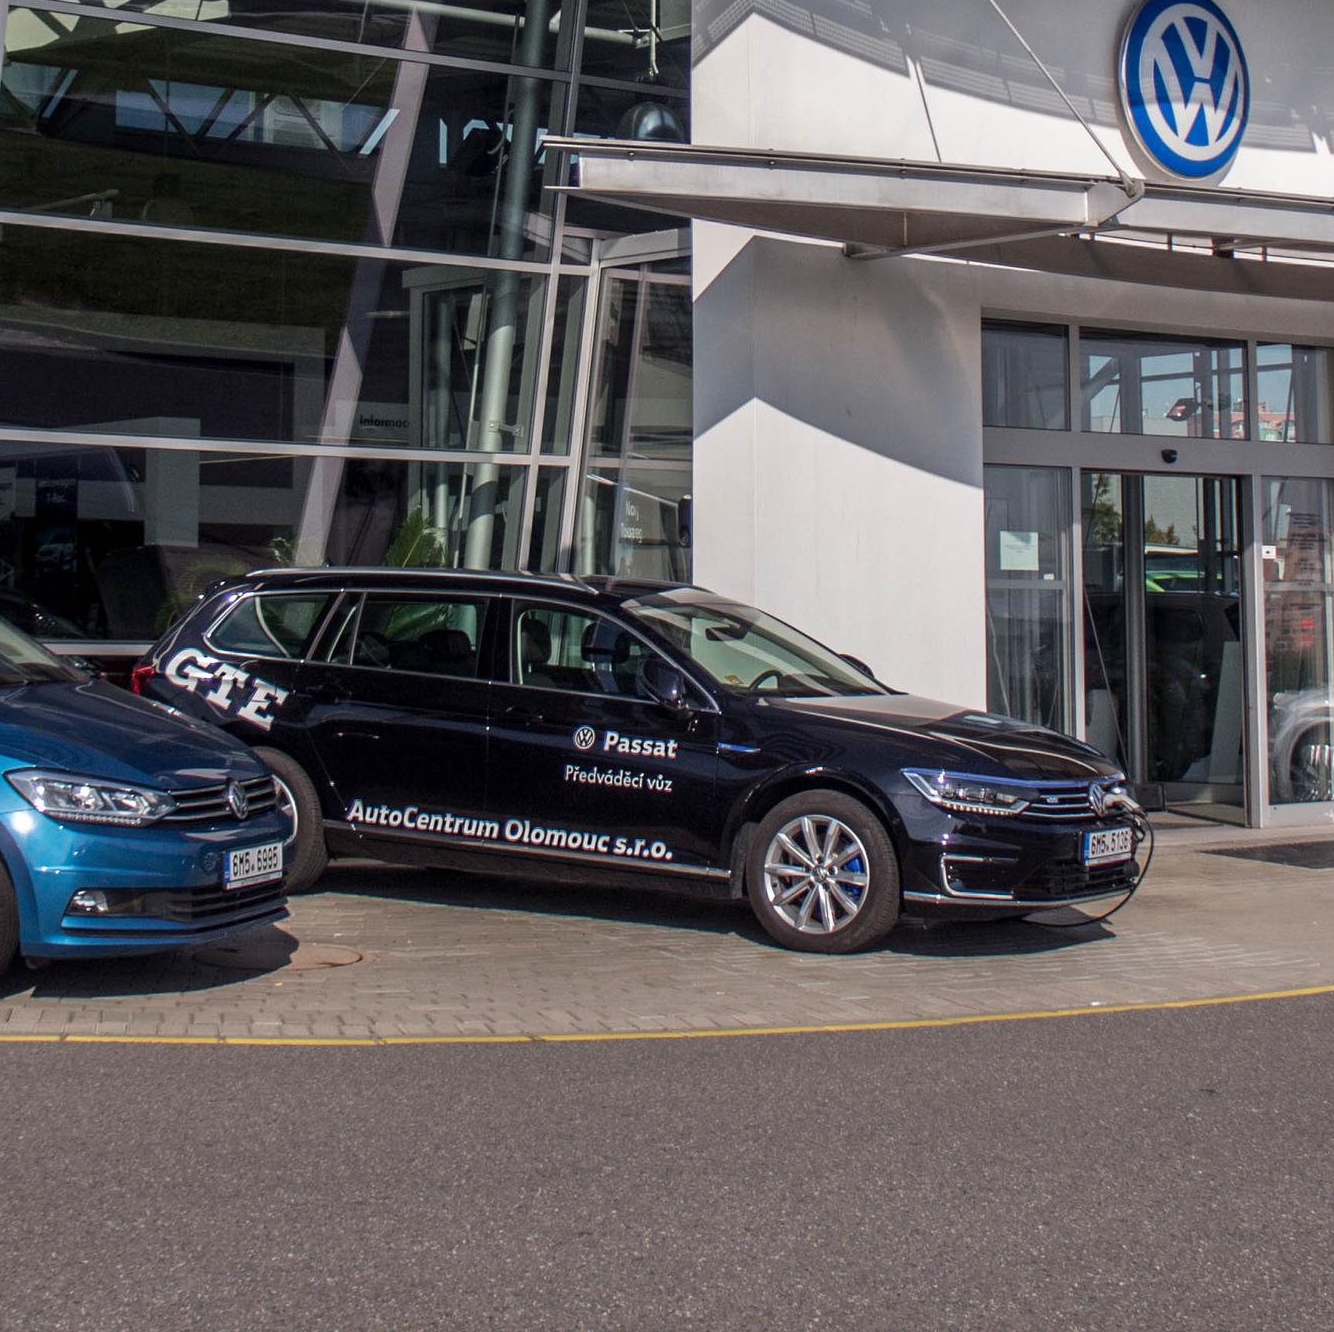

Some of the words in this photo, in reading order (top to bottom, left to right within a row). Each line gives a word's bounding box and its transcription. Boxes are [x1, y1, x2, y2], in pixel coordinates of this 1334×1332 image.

[165, 648, 289, 731] GTE
[603, 731, 679, 759] Passat
[564, 764, 644, 788] Předváděcí
[647, 773, 674, 792] vůz
[346, 799, 499, 839] AutoCentrum
[504, 818, 610, 852] Olomouc
[612, 836, 674, 861] s.r.o.
[232, 852, 251, 877] 6M5
[256, 846, 279, 872] 6995
